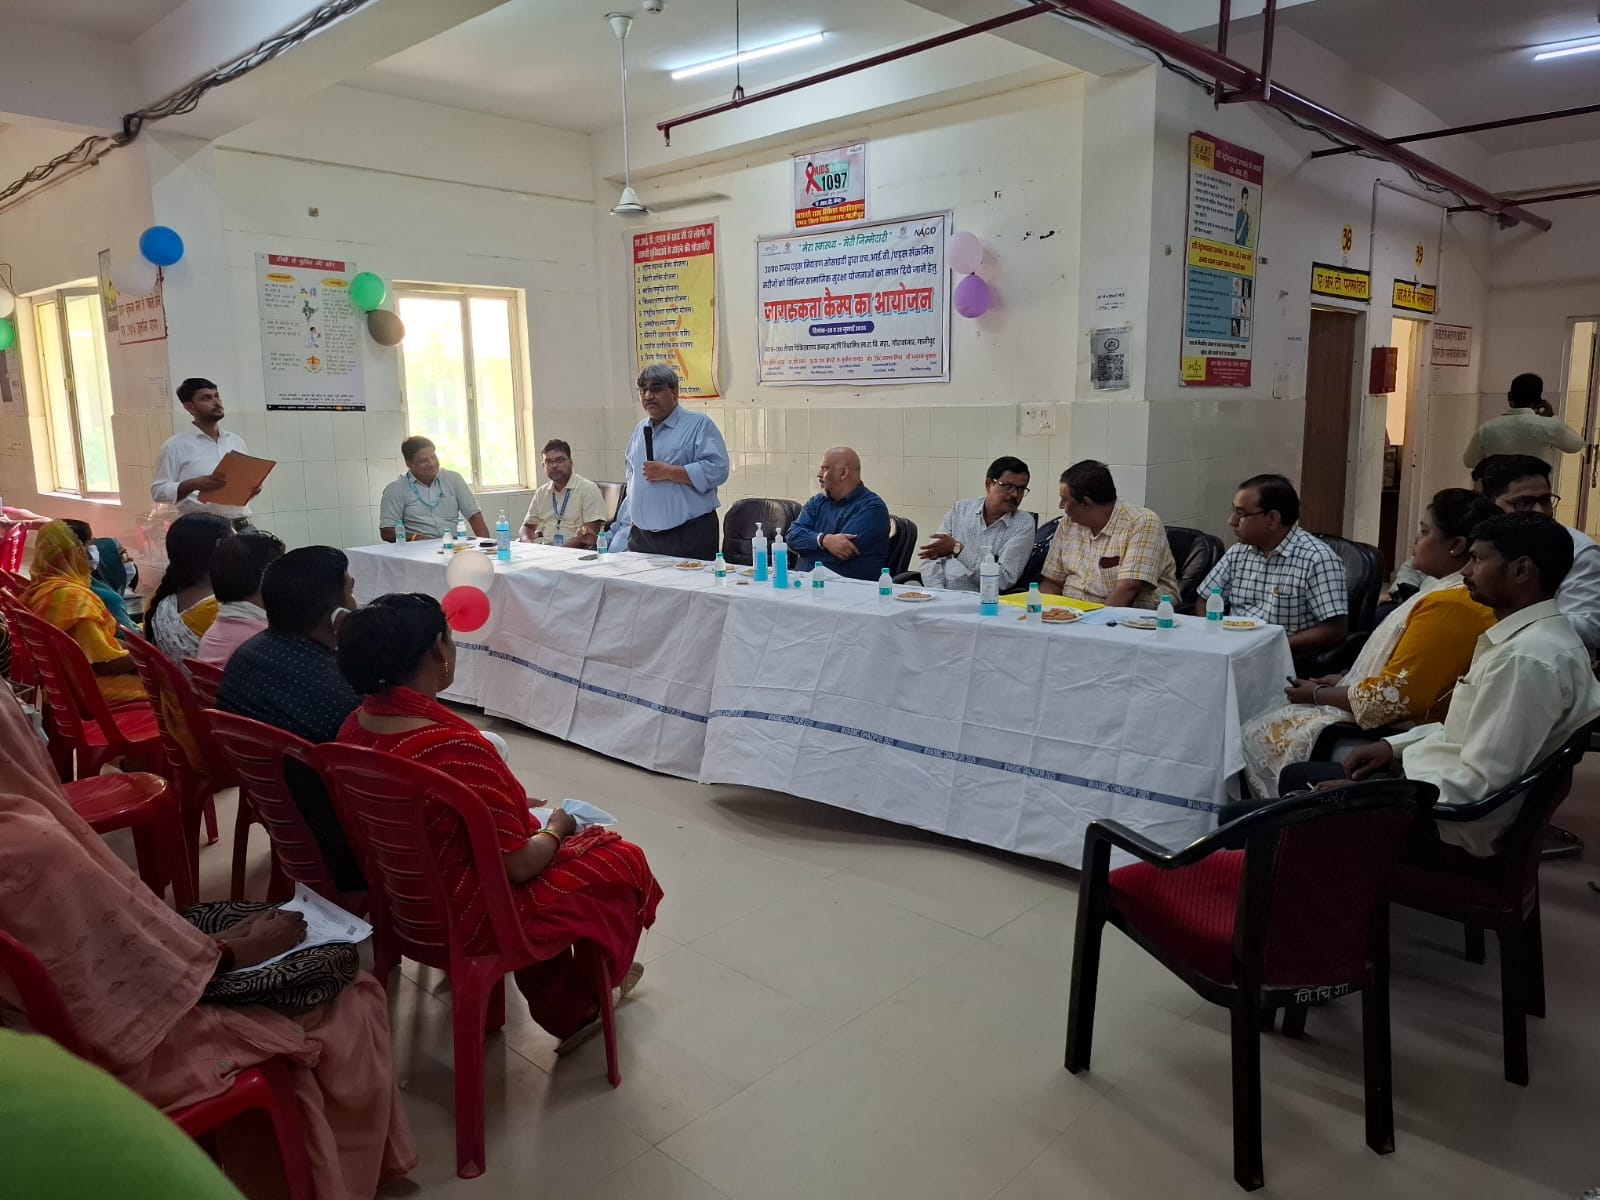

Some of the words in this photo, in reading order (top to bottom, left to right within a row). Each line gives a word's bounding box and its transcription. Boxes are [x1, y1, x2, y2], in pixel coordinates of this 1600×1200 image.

[821, 171, 848, 192] 1097
[914, 225, 937, 238] NACO
[814, 240, 838, 251] स्वास्थ्य
[843, 234, 855, 247] मेरी
[875, 269, 884, 278] का
[912, 263, 927, 273] जाने
[927, 261, 937, 275] हेतु
[854, 292, 873, 317] का
[874, 281, 934, 314] आयोजन
